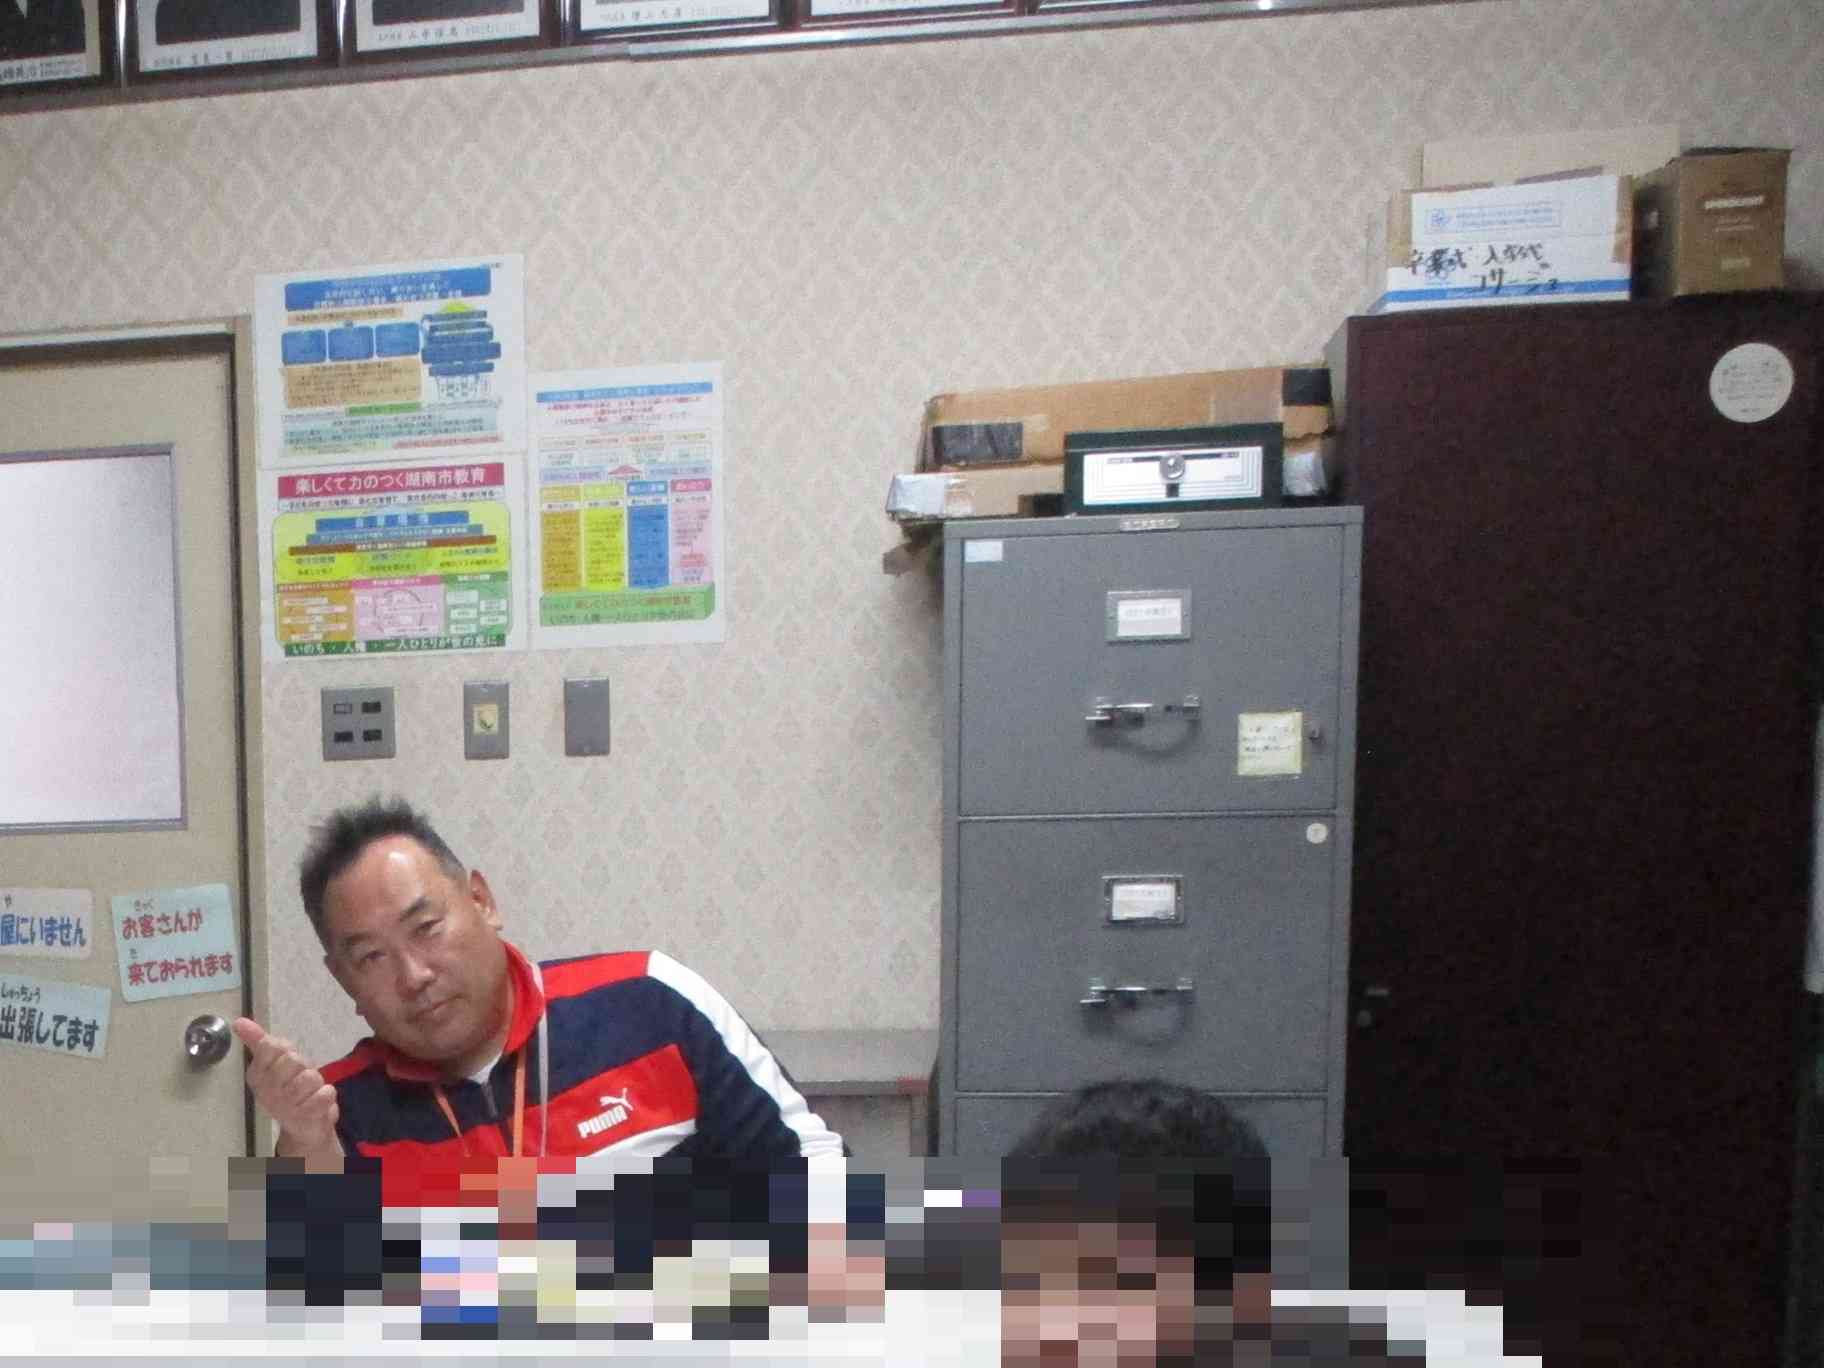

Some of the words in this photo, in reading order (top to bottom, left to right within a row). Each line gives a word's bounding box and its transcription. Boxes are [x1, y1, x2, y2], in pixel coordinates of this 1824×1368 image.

[122, 910, 204, 940] お客さんが
[128, 952, 234, 986] 来ておられます
[576, 1104, 628, 1139] PUMA
